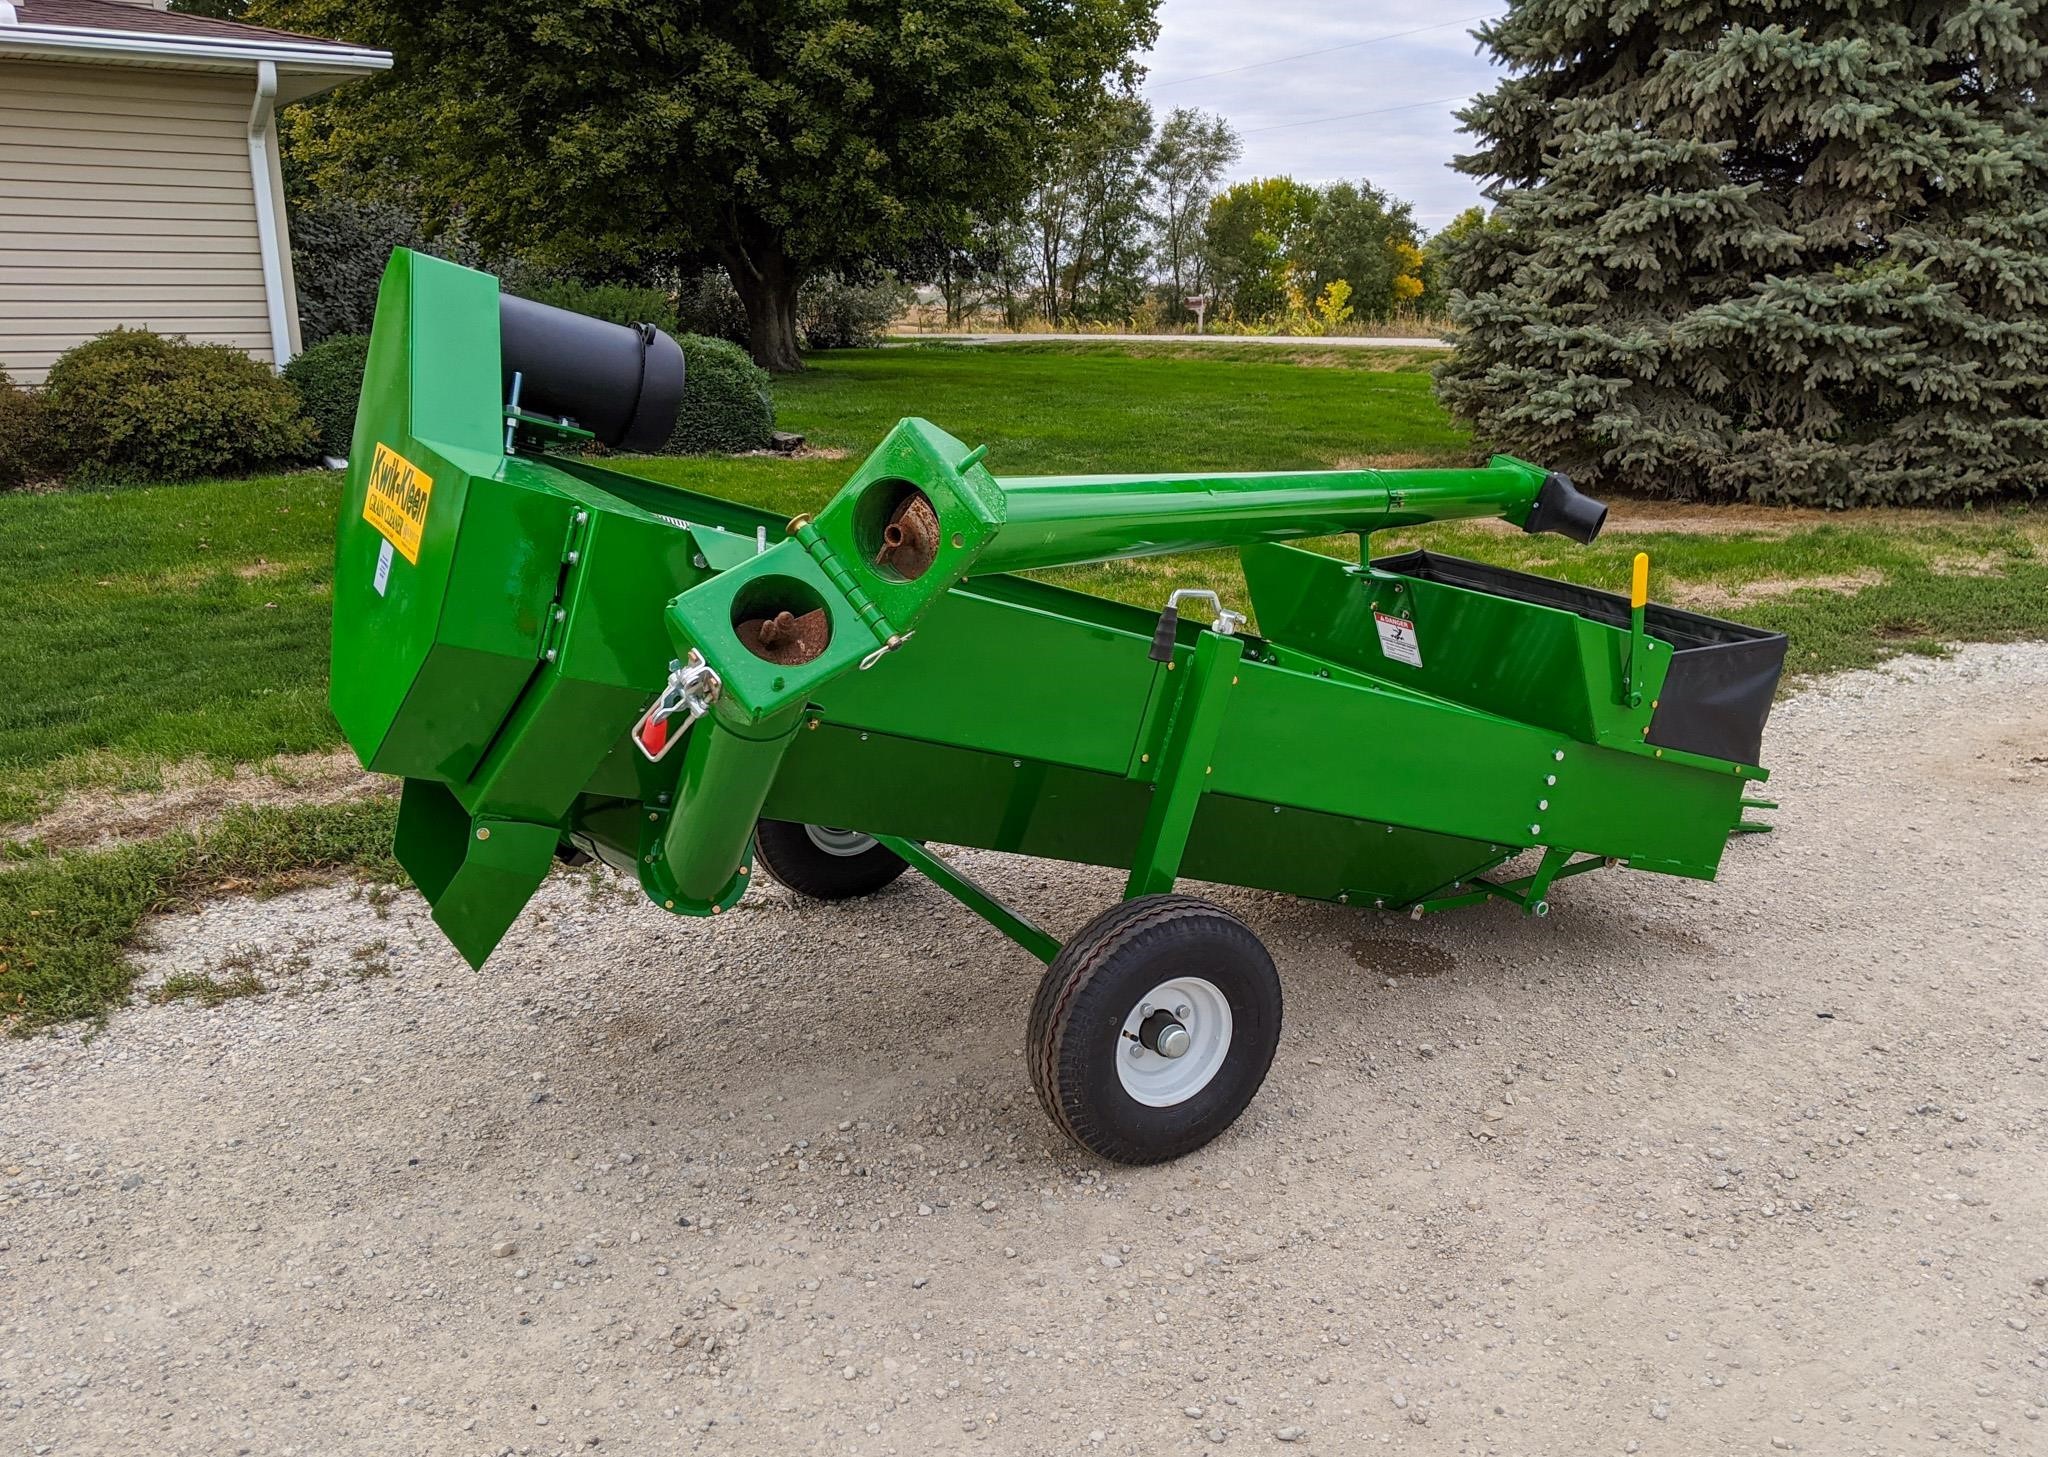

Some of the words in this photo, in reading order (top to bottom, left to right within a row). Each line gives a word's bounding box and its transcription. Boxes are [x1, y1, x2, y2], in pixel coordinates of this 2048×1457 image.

[370, 448, 427, 525] Kwik-Kleen
[369, 493, 384, 519] GRAIN
[384, 504, 404, 537] CLEANER
[1385, 616, 1409, 628] DANGER
